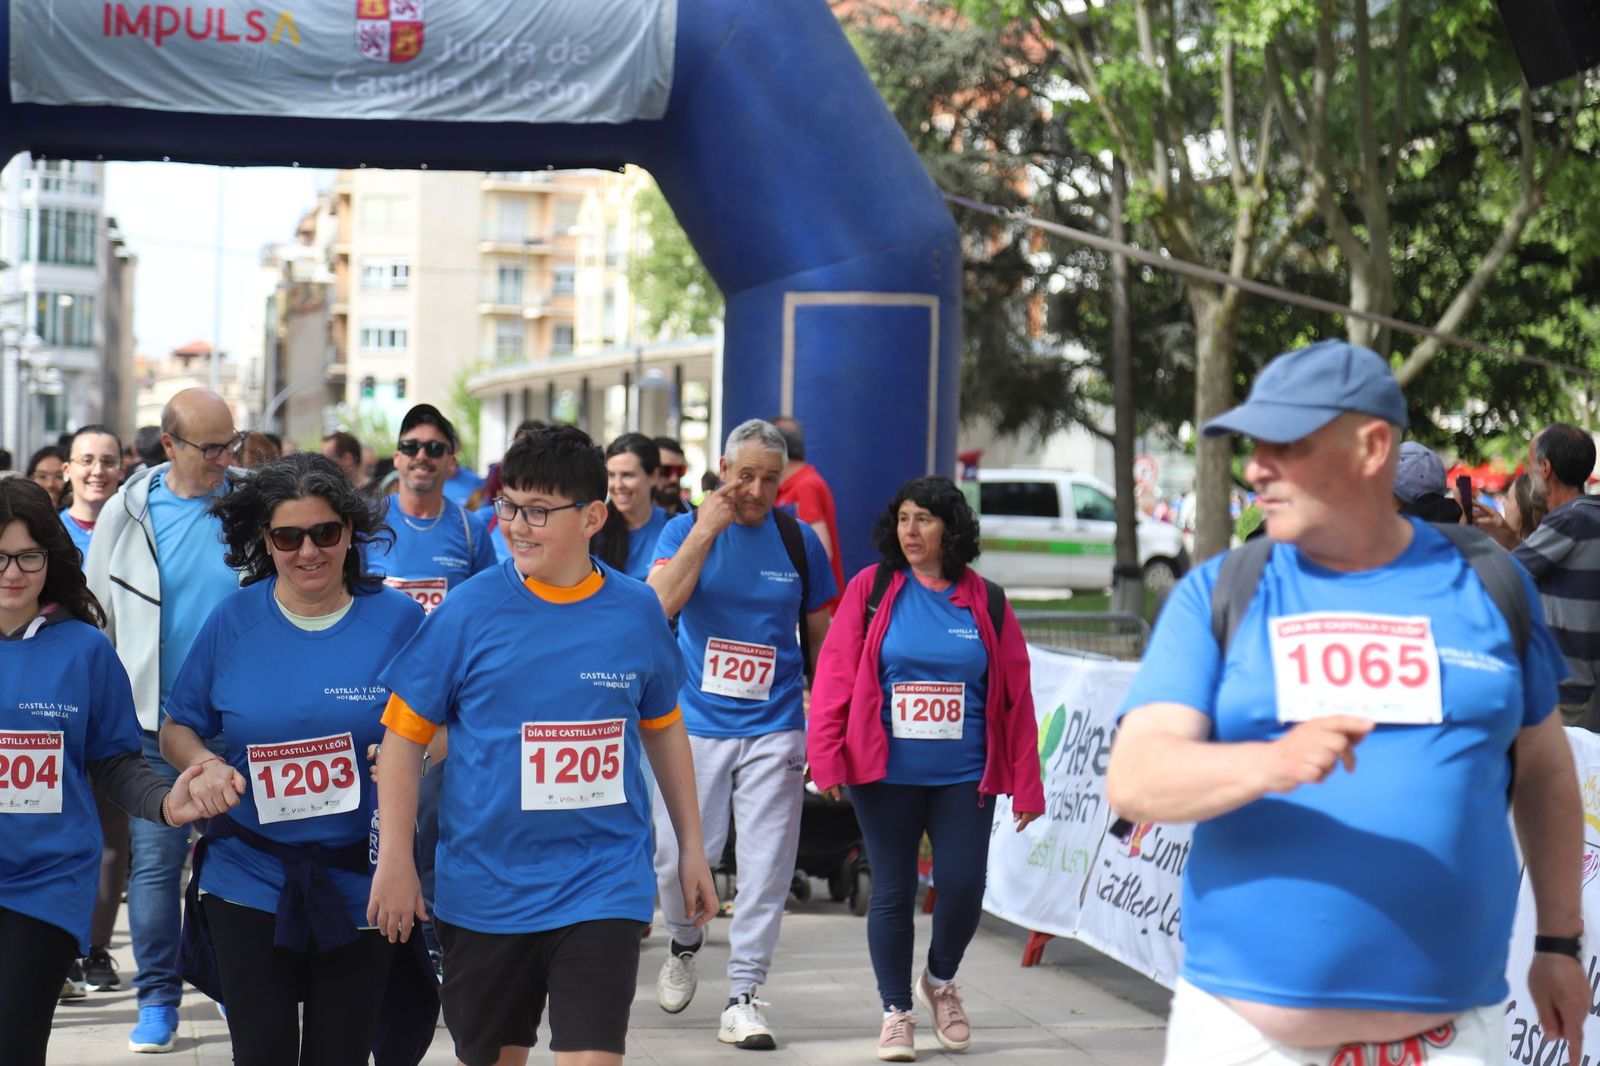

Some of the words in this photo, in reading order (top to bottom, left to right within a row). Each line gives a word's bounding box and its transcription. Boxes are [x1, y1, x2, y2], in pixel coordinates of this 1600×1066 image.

[433, 38, 537, 64] Junta
[545, 37, 592, 65] de
[330, 69, 460, 98] Castilla
[470, 78, 492, 104] y
[501, 71, 589, 102] León
[580, 672, 617, 680] CASTILLA
[709, 655, 771, 684] 1207
[1287, 642, 1430, 689] 1065
[897, 698, 961, 722] 1208
[37, 736, 59, 745] LEÓN
[527, 729, 543, 737] DÍA
[545, 729, 557, 737] DE
[558, 729, 597, 737] CASTILLA
[603, 725, 621, 734] LEÓN
[252, 749, 267, 758] DÍA
[267, 750, 279, 758] DE
[279, 745, 317, 756] CASTILLA
[324, 740, 348, 750] LEÓN
[258, 757, 355, 798] 1203
[529, 743, 620, 784] 1205
